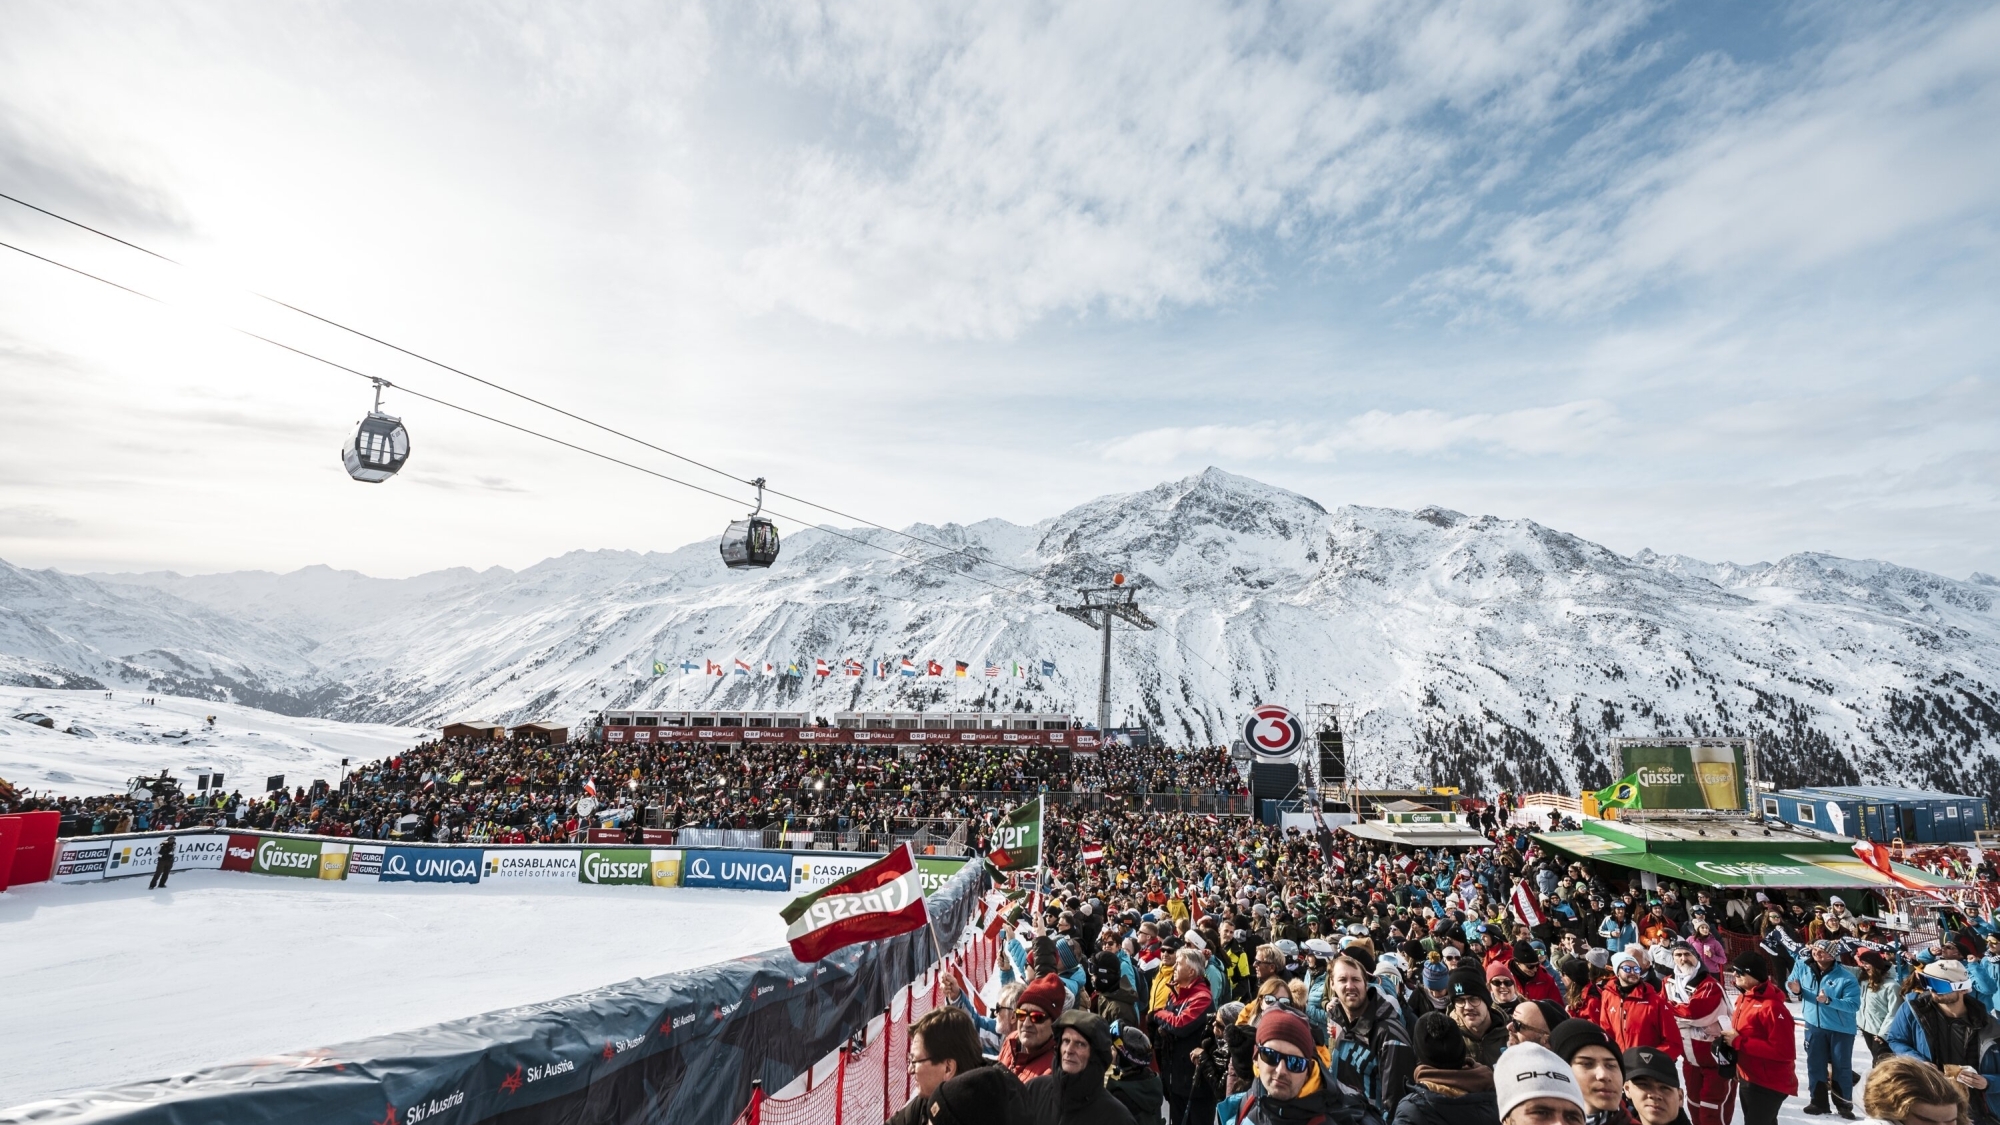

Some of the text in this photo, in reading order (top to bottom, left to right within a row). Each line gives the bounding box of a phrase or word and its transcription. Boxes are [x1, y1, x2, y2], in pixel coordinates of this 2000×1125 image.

[1637, 767, 1685, 787] Gösser
[78, 850, 107, 858] GURGL
[259, 841, 318, 870] Gösser
[502, 858, 577, 868] CASABLANCA
[75, 864, 103, 872] GURGL
[415, 859, 477, 877] UNIQA
[501, 869, 577, 878] hotelsoftware
[584, 853, 648, 883] Gösser
[720, 863, 787, 883] UNIQA
[1695, 861, 1804, 876] Gösser
[672, 1011, 696, 1029] Ski Austria
[616, 1040, 627, 1053] Ski
[527, 1059, 575, 1083] Ski Austria
[1516, 1071, 1570, 1083] DKB
[406, 1090, 465, 1125] Ski Austria
